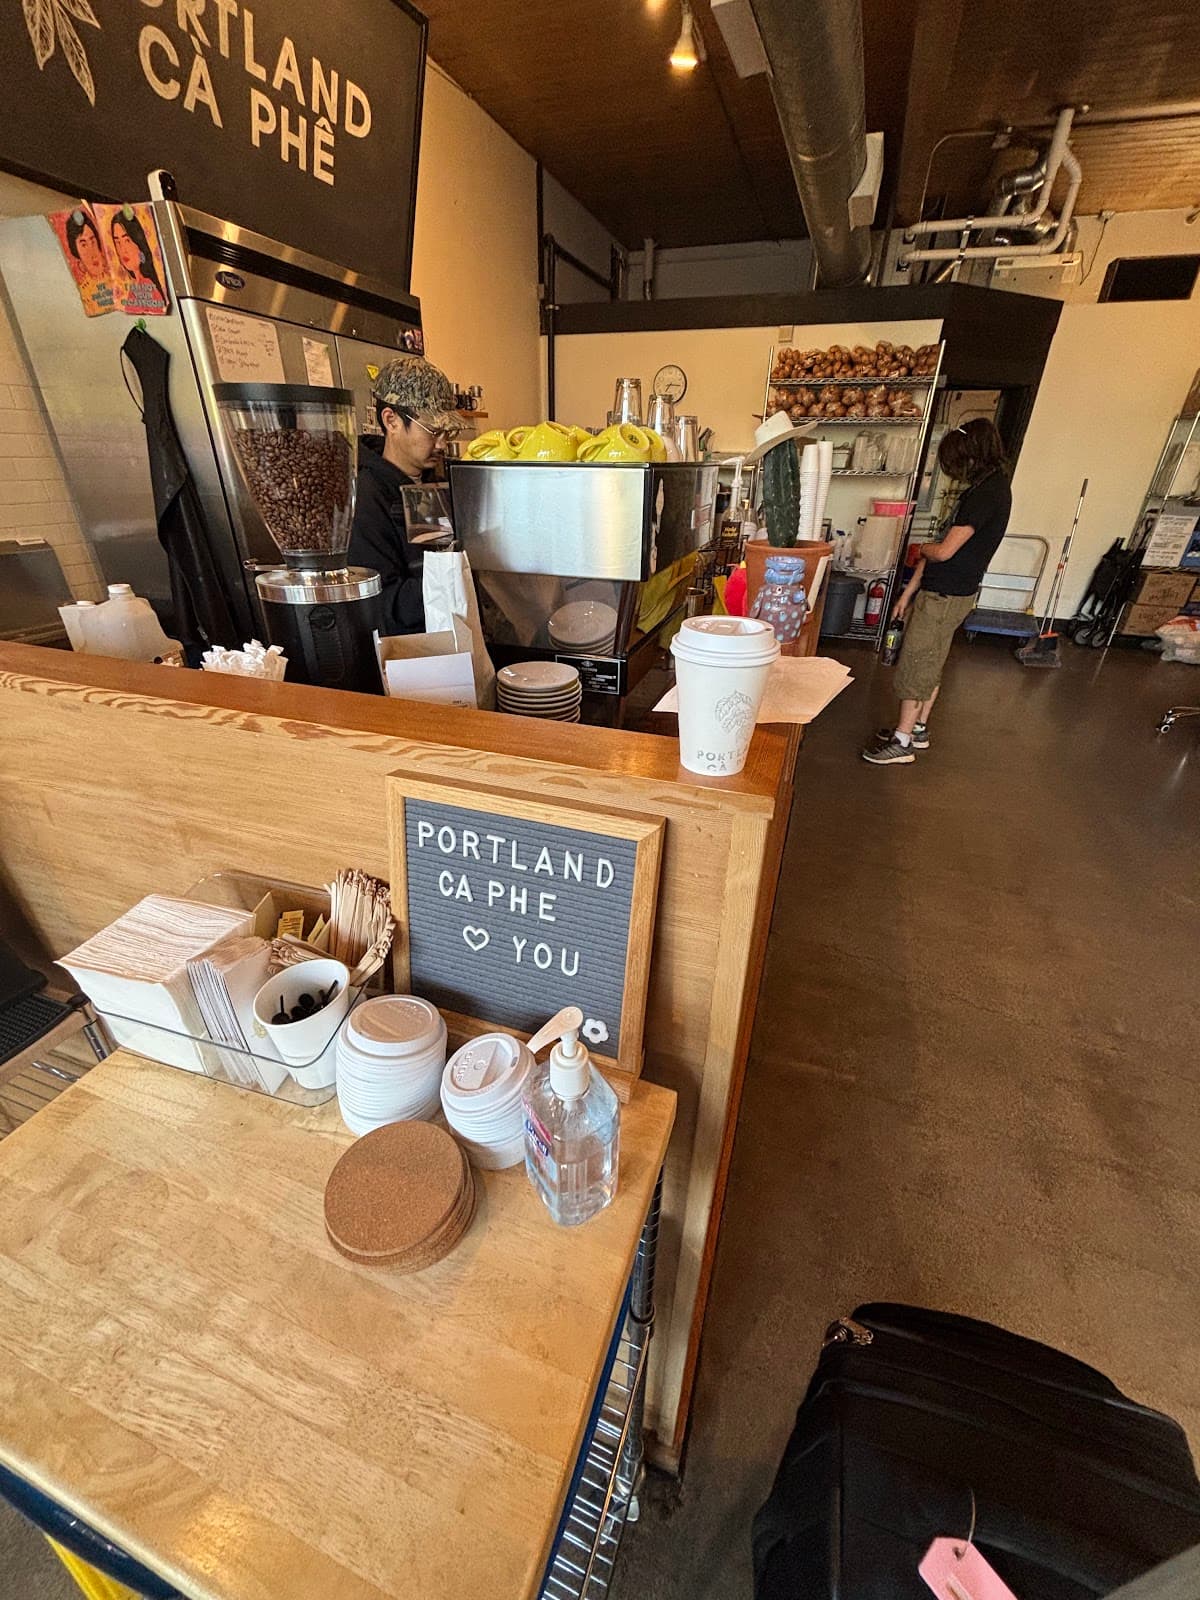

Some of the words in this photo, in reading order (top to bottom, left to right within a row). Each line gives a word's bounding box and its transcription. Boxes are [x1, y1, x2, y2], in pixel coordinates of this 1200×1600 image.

[139, 0, 372, 138] RTLAND
[138, 25, 223, 129] CÀ
[250, 87, 335, 187] PHÊ
[417, 820, 615, 889] PORTLAND
[438, 870, 474, 902] CA
[488, 880, 557, 921] PHE
[512, 935, 580, 977] YOU
